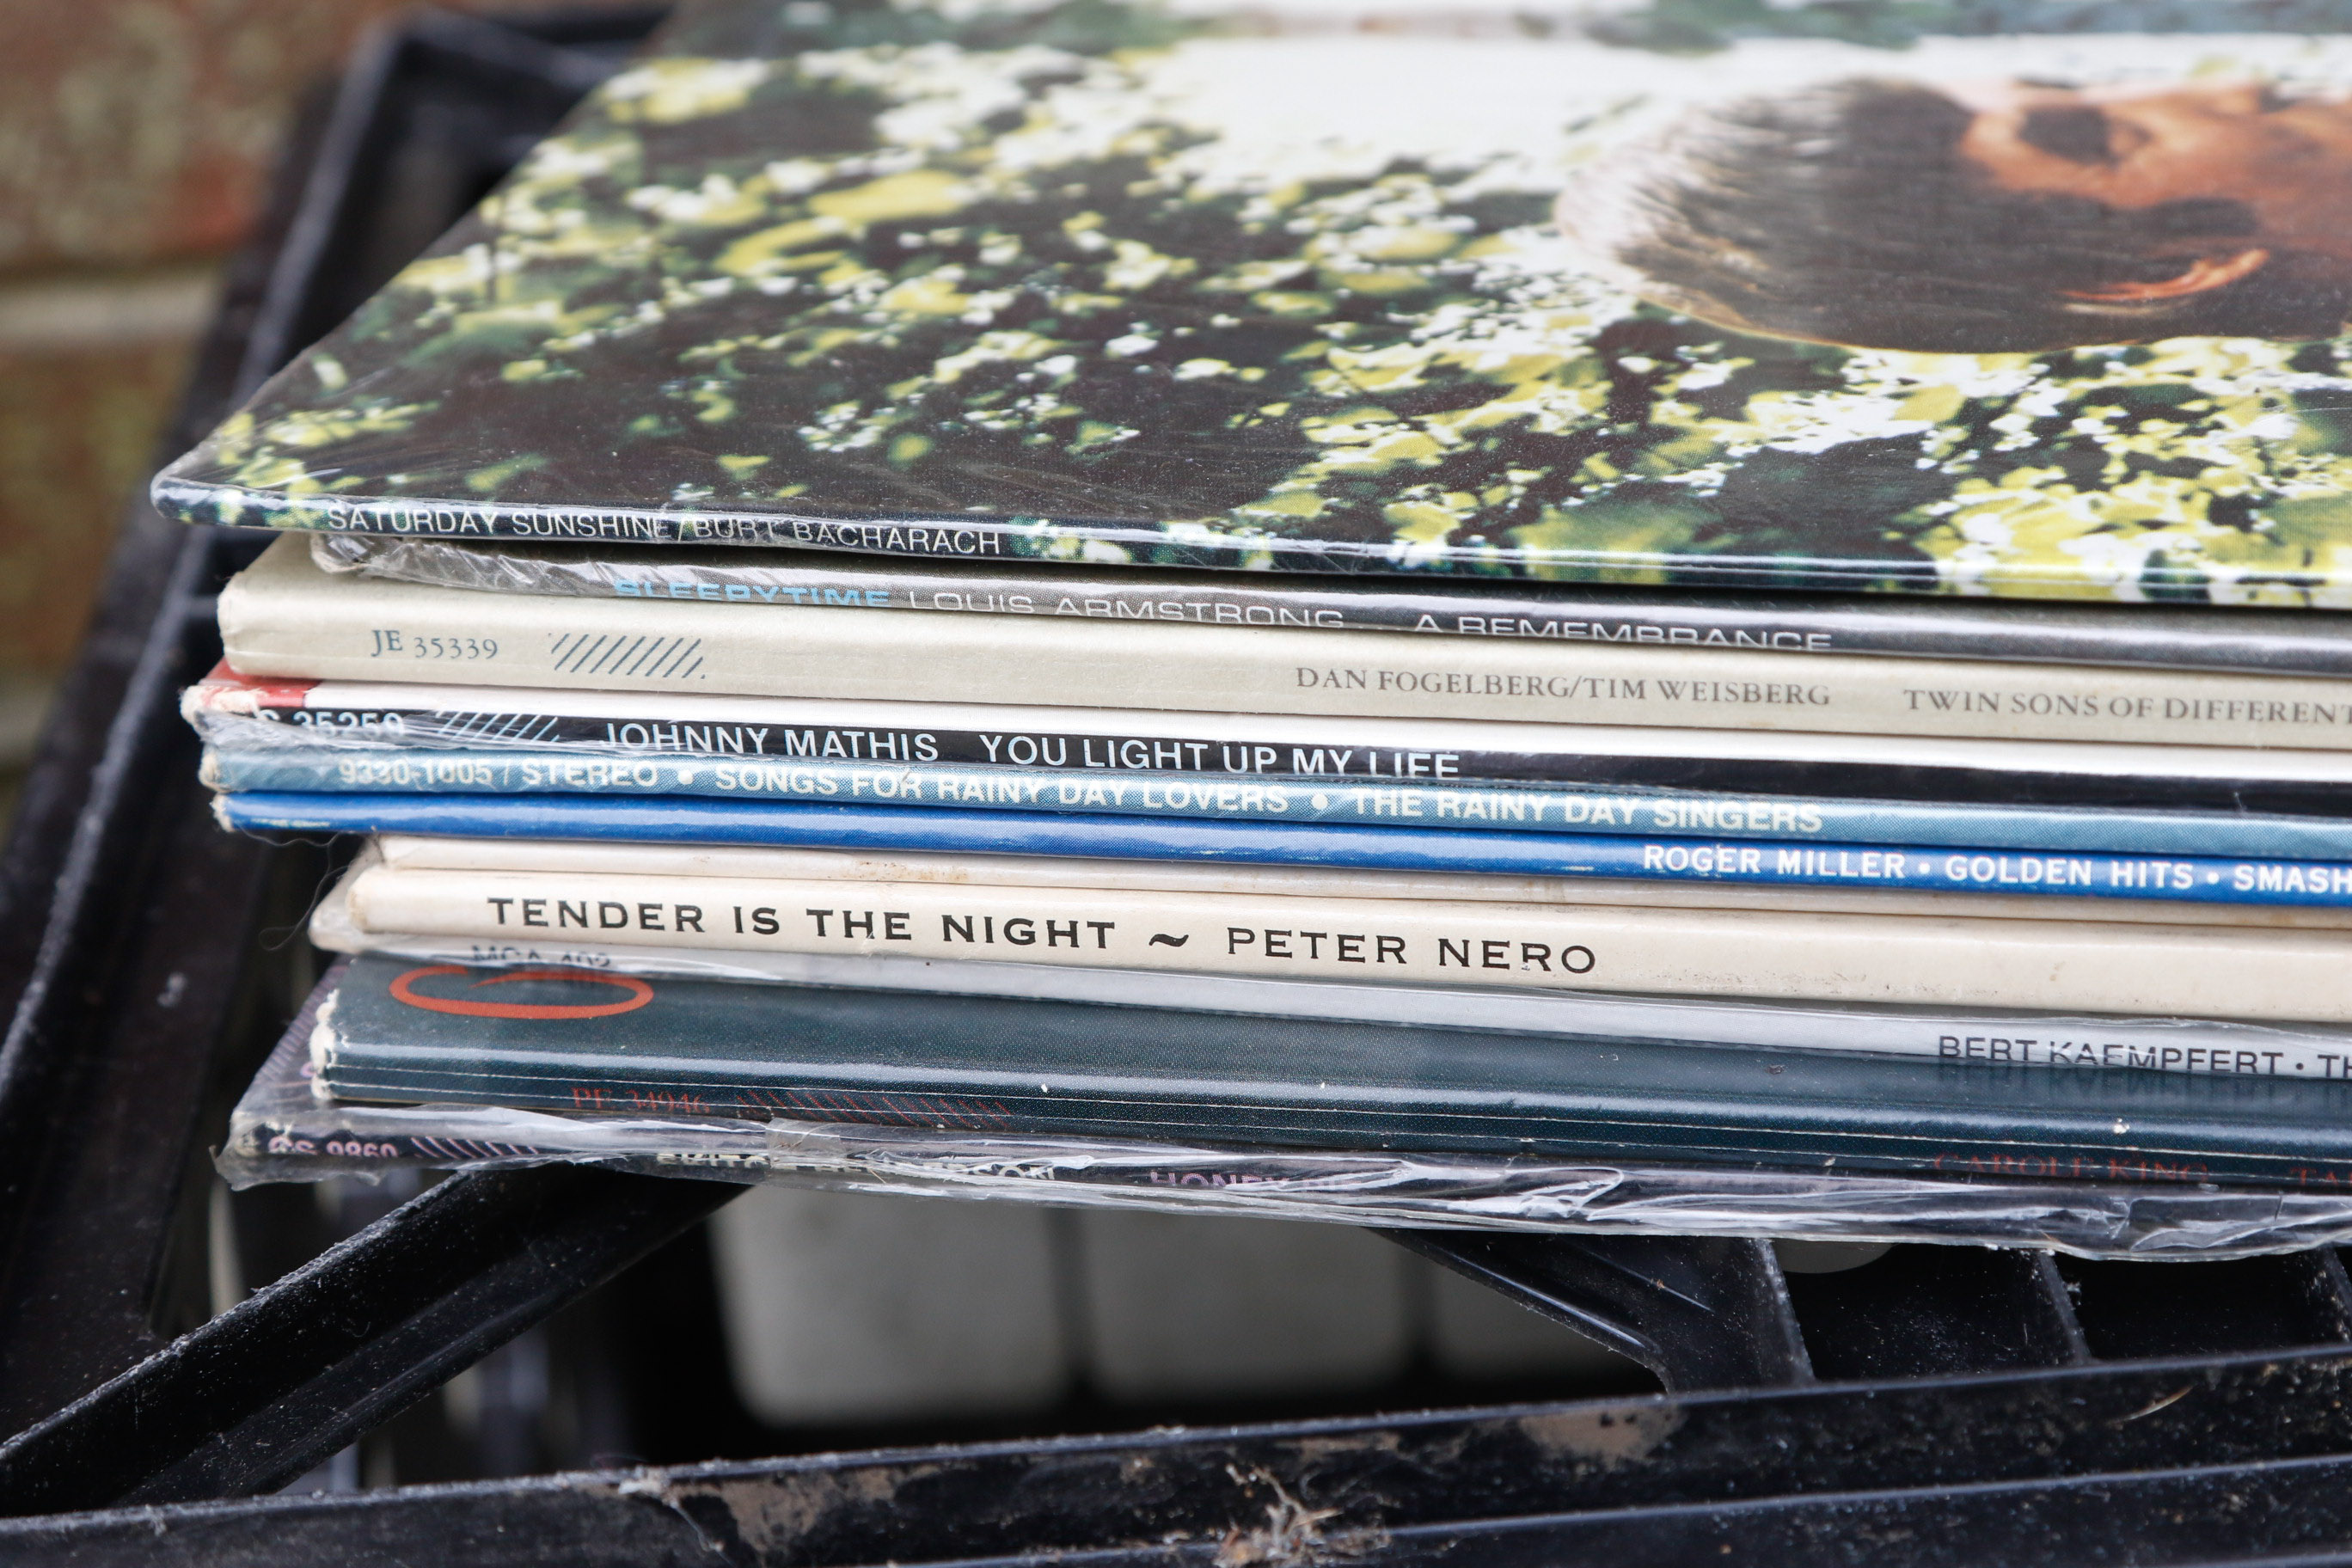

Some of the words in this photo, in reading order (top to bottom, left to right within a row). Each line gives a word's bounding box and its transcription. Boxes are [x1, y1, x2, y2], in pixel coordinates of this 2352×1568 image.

[328, 507, 499, 535] SATURDAY
[793, 522, 1000, 554] BACHARACH
[614, 579, 891, 607] SLEEPYTIME
[910, 591, 1034, 614] LOUIS
[1415, 613, 1442, 632] A
[1459, 616, 1832, 650] REMEMBRANCE
[371, 629, 402, 657] JE
[414, 635, 498, 659] 35339
[1296, 667, 1367, 689] DAN
[1657, 680, 1829, 706] WEISBERG
[1904, 689, 2000, 712] TWIN
[2011, 693, 2098, 716] SONS
[2110, 696, 2152, 717] OF
[600, 723, 769, 754] JOHNNY
[785, 729, 939, 762] MATHIS
[979, 735, 1066, 766] YOU
[1086, 738, 1209, 771] LIGHT
[1222, 745, 1277, 773] UP
[1293, 748, 1353, 775] MY
[1370, 751, 1460, 779] LIFE
[520, 760, 658, 787] STEREO
[715, 765, 846, 794] SONGS
[853, 769, 928, 799] FOR
[938, 775, 1047, 805] RAINY
[1058, 780, 1135, 809] DAY
[1142, 782, 1289, 814] LOVERS
[1350, 787, 1423, 817] THE
[1436, 792, 1551, 823] RAINY
[1565, 795, 1639, 825] DAY
[1653, 800, 1822, 833] SINGERS
[1644, 844, 1761, 873] ROGER
[1778, 849, 1906, 880] MILLER
[1945, 854, 2092, 887] GOLDEN
[2110, 861, 2195, 889] HITS
[2233, 864, 2352, 895] SMASH
[487, 897, 705, 934] TENDER
[734, 905, 780, 935] IS
[805, 908, 912, 941] THE
[942, 914, 1116, 948] NIGHT
[1228, 926, 1407, 965] PETER
[1438, 938, 1596, 974] NERO
[1939, 1035, 2037, 1062] BERT
[2049, 1040, 2283, 1074] KAEMPFERT
[2289, 1167, 2352, 1186] TA
